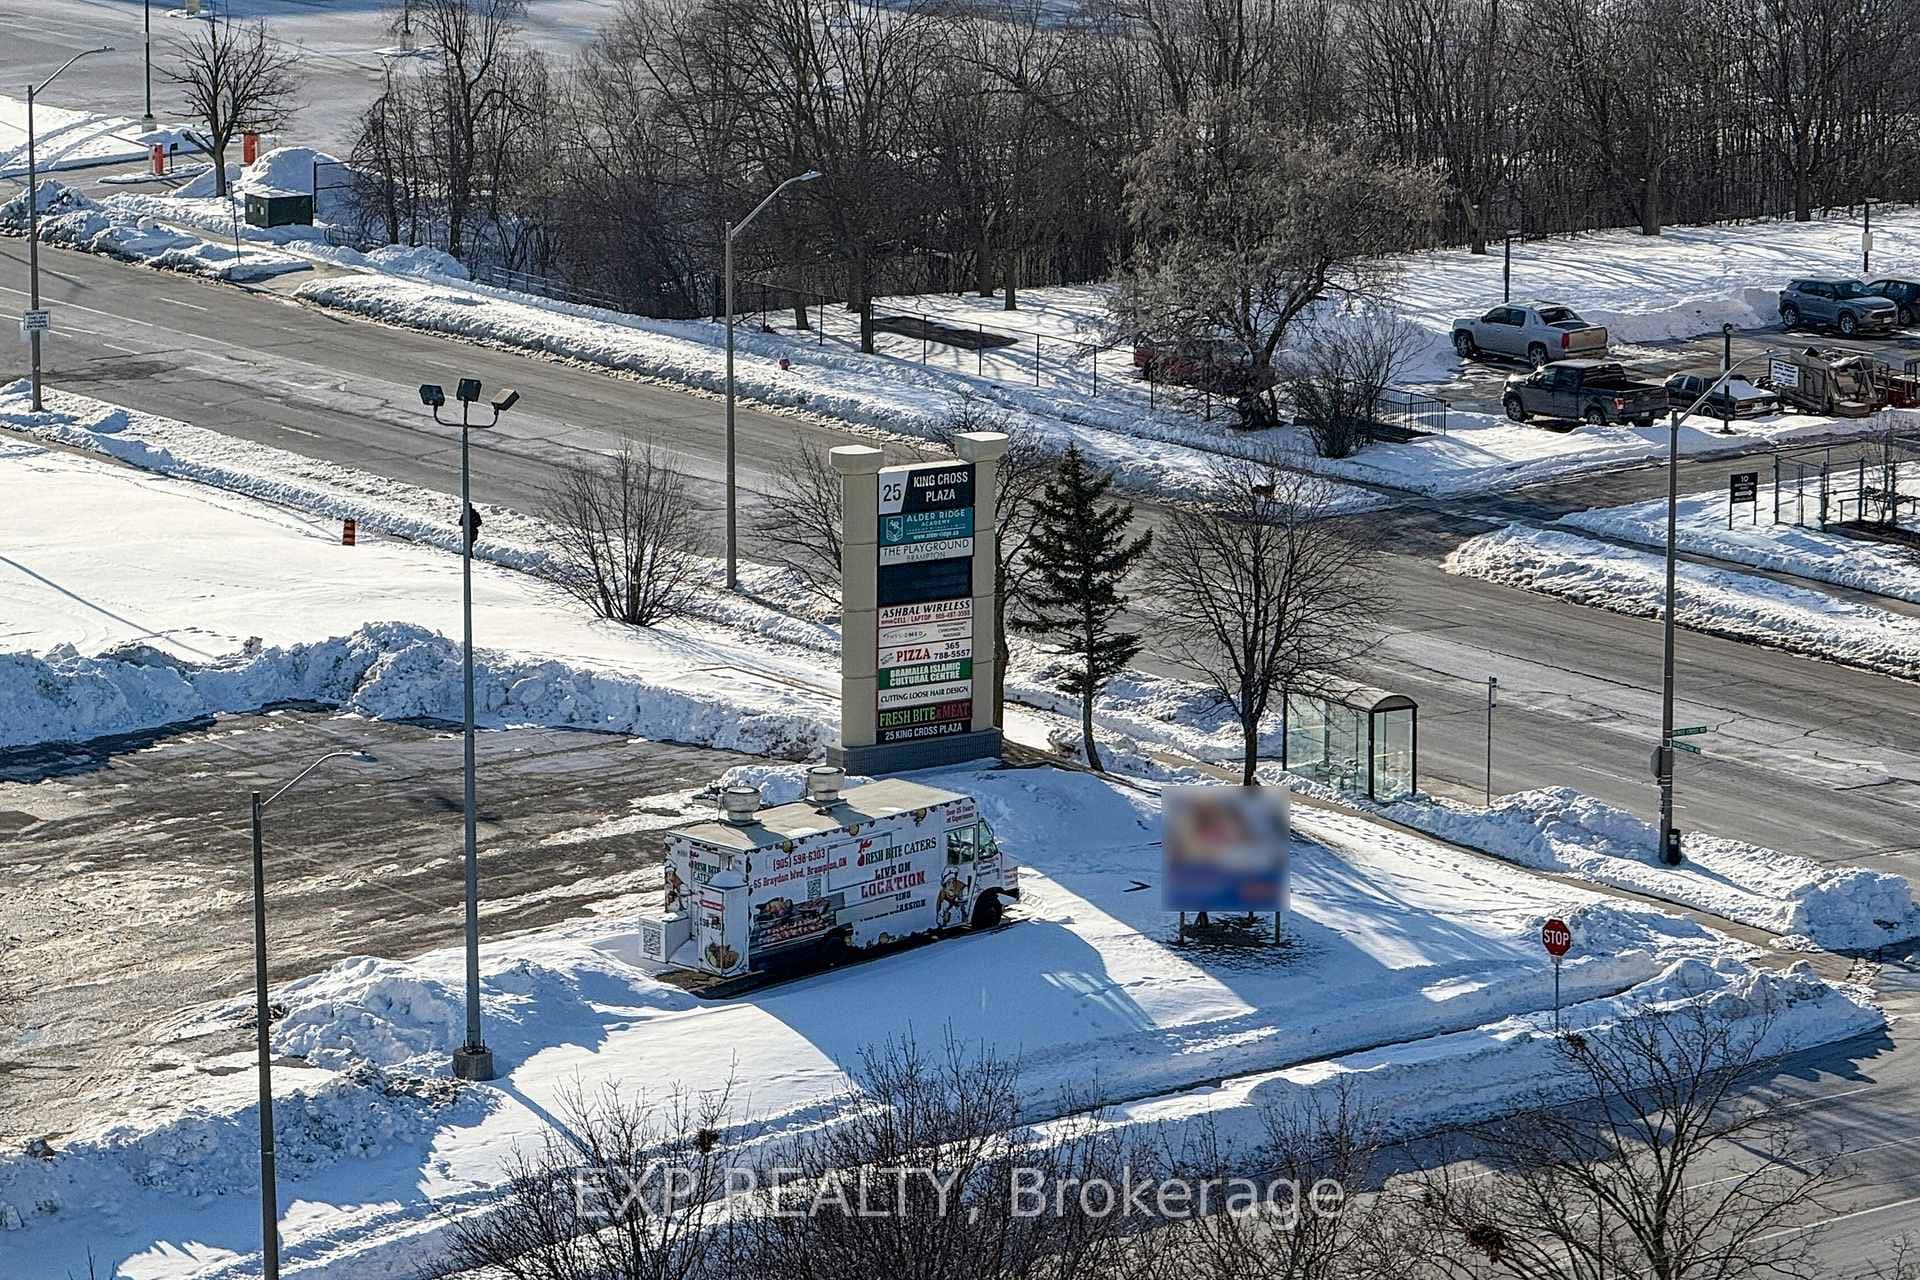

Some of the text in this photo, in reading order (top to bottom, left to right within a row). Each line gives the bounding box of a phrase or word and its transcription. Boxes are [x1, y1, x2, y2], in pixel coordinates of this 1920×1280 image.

[913, 471, 968, 488] KING CROSS
[883, 483, 901, 502] 25
[926, 489, 956, 502] PLAZA
[906, 508, 966, 523] ALDER RIDGE
[921, 519, 950, 527] ACADEMY
[884, 539, 969, 558] THE PLAYGROUND
[881, 600, 970, 618] ASHBAL WIRELESS
[911, 614, 931, 623] LAPTOP
[945, 641, 960, 650] 365
[896, 648, 930, 662] PIZZA
[890, 662, 961, 678] BRAMALEA ISLAMIC
[890, 671, 960, 687] CULTURAL CENTRE
[881, 685, 968, 703] CUTTING LOOSE HAIR DESIGN
[880, 710, 911, 727] FRESH
[913, 706, 936, 723] BITE
[941, 702, 969, 719] MEAT
[885, 722, 962, 741] 25 KING CROSS PLAZA
[885, 844, 902, 861] BITE
[904, 837, 937, 855] CATERS
[773, 856, 792, 871] (905)
[875, 861, 911, 880] LIVE ON
[861, 870, 926, 898] LOCATION
[1543, 929, 1569, 946] STOP
